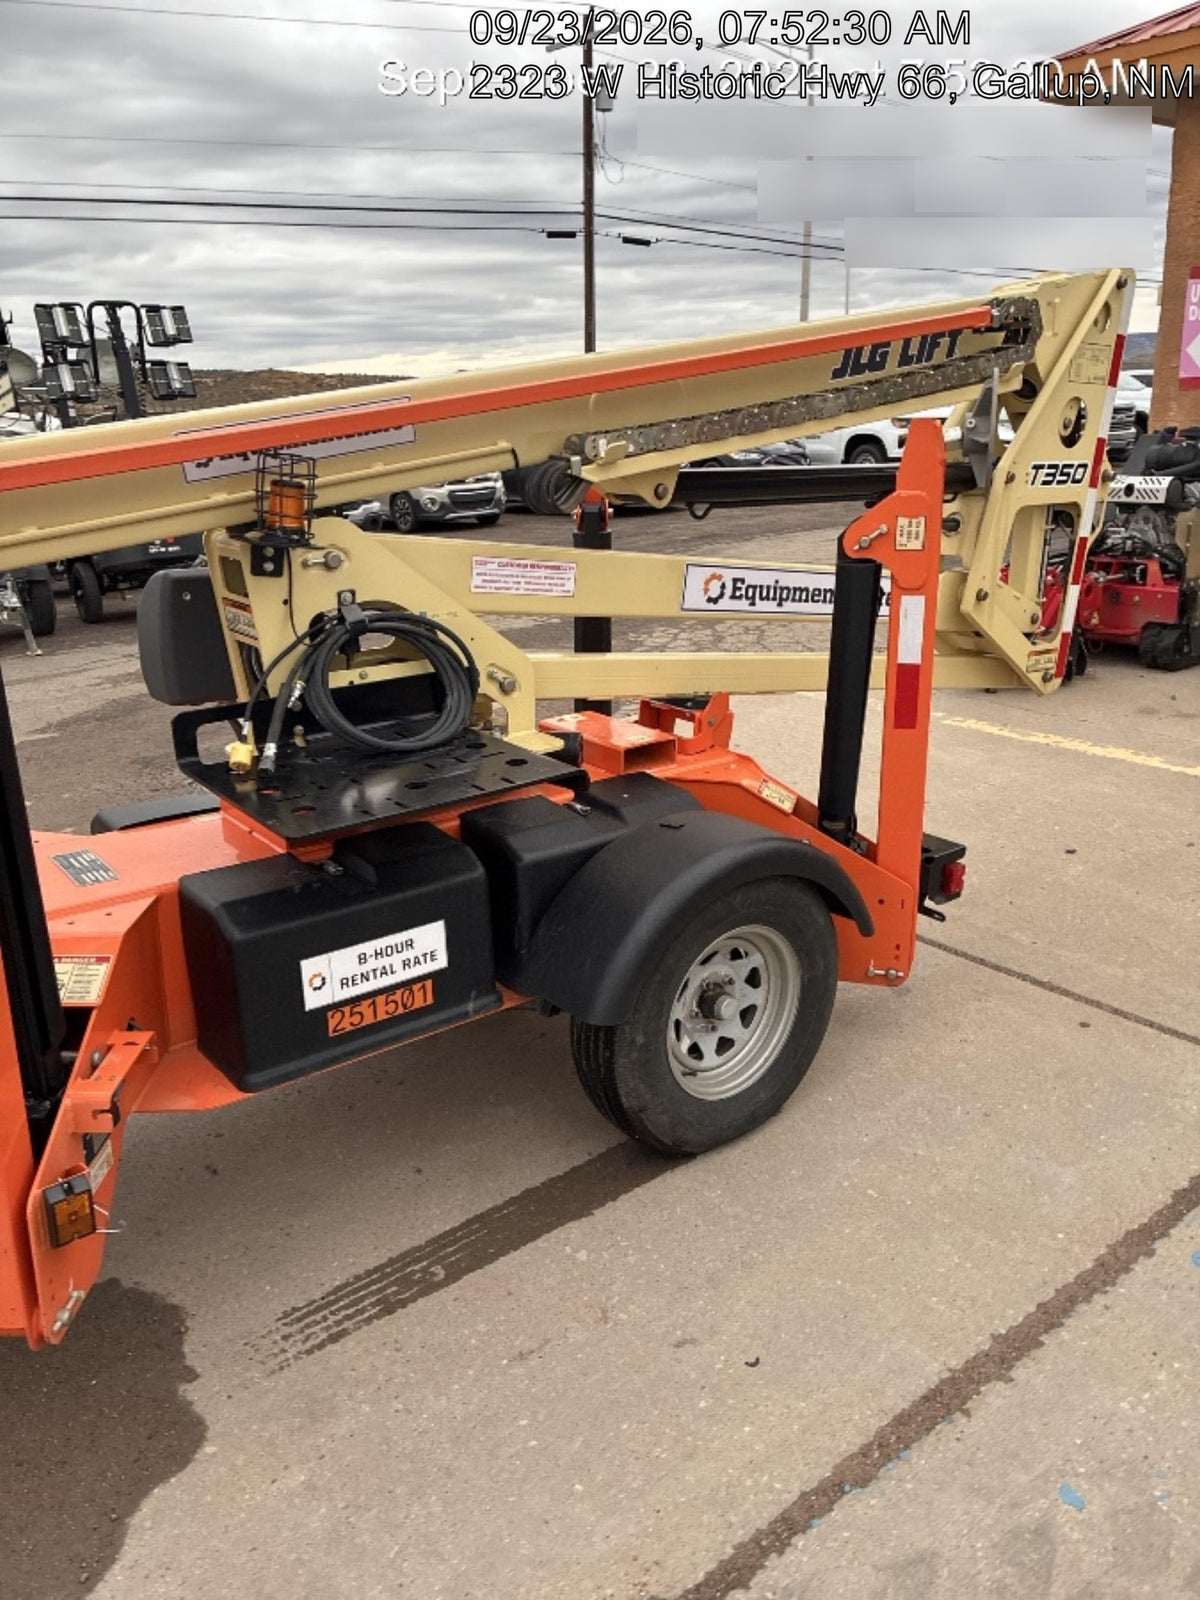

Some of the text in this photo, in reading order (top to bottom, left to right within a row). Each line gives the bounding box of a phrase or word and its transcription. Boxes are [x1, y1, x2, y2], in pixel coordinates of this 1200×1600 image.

[831, 329, 963, 380] JLG LIFT
[1031, 462, 1089, 486] T350
[340, 949, 438, 991] RENTAL RATE
[357, 938, 415, 965] 8-HOUR
[330, 982, 428, 1034] 251501
